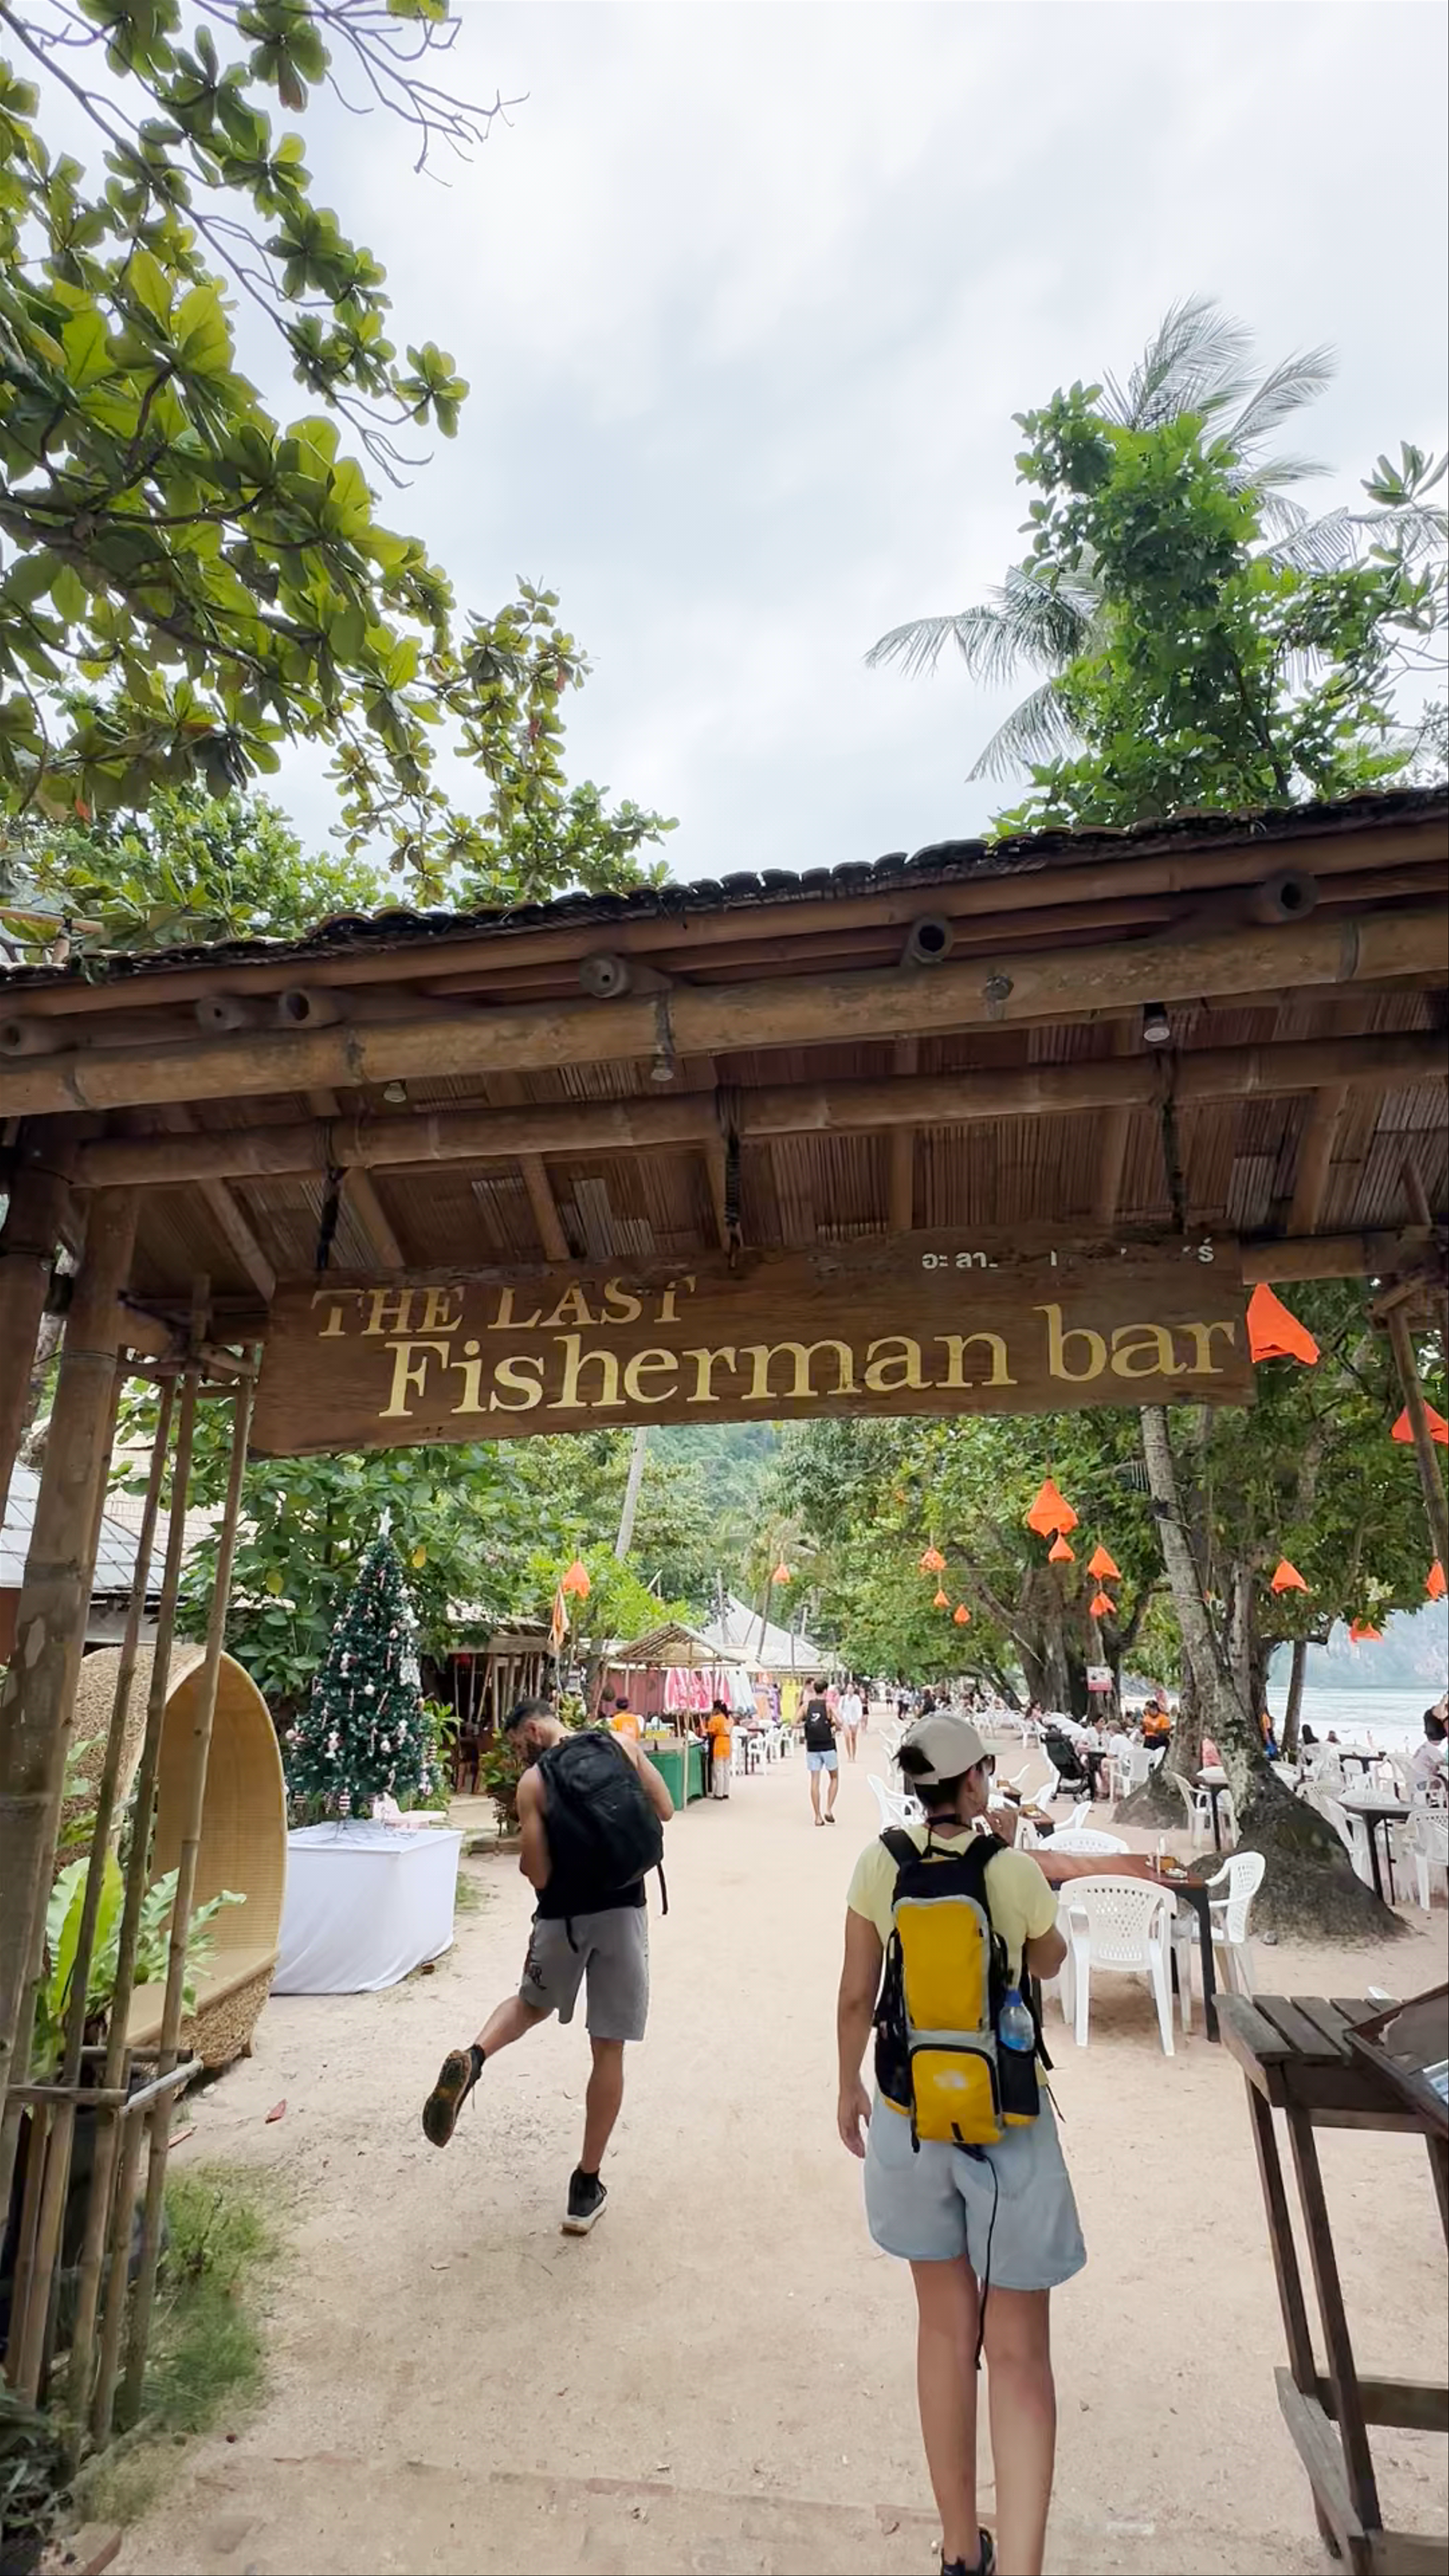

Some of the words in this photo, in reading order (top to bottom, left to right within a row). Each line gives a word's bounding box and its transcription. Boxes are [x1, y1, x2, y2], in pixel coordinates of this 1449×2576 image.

[311, 1286, 465, 1336] THE
[378, 1332, 1017, 1418] Fisherman
[1033, 1304, 1235, 1381] bar
